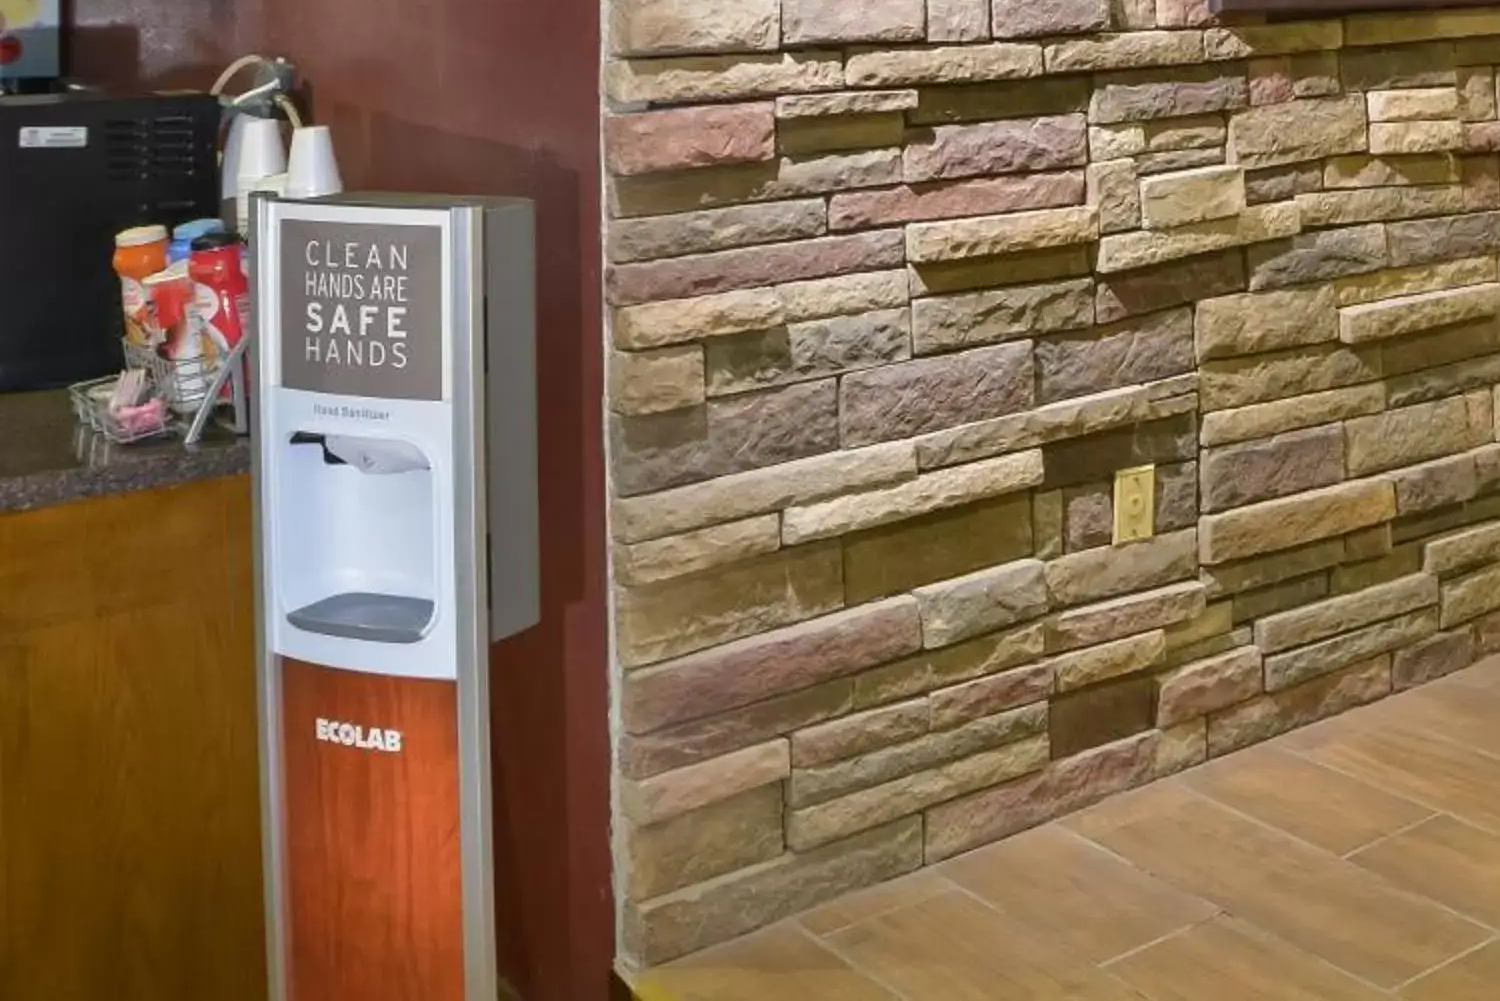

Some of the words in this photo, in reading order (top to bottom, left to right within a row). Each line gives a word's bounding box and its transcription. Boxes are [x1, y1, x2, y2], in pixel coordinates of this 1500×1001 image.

[305, 239, 408, 271] CLEAN
[305, 270, 365, 300] HANDS
[370, 275, 408, 302] ARE
[306, 302, 408, 339] SAFE
[305, 336, 408, 369] HANDS
[315, 718, 401, 752] ECOLAB
